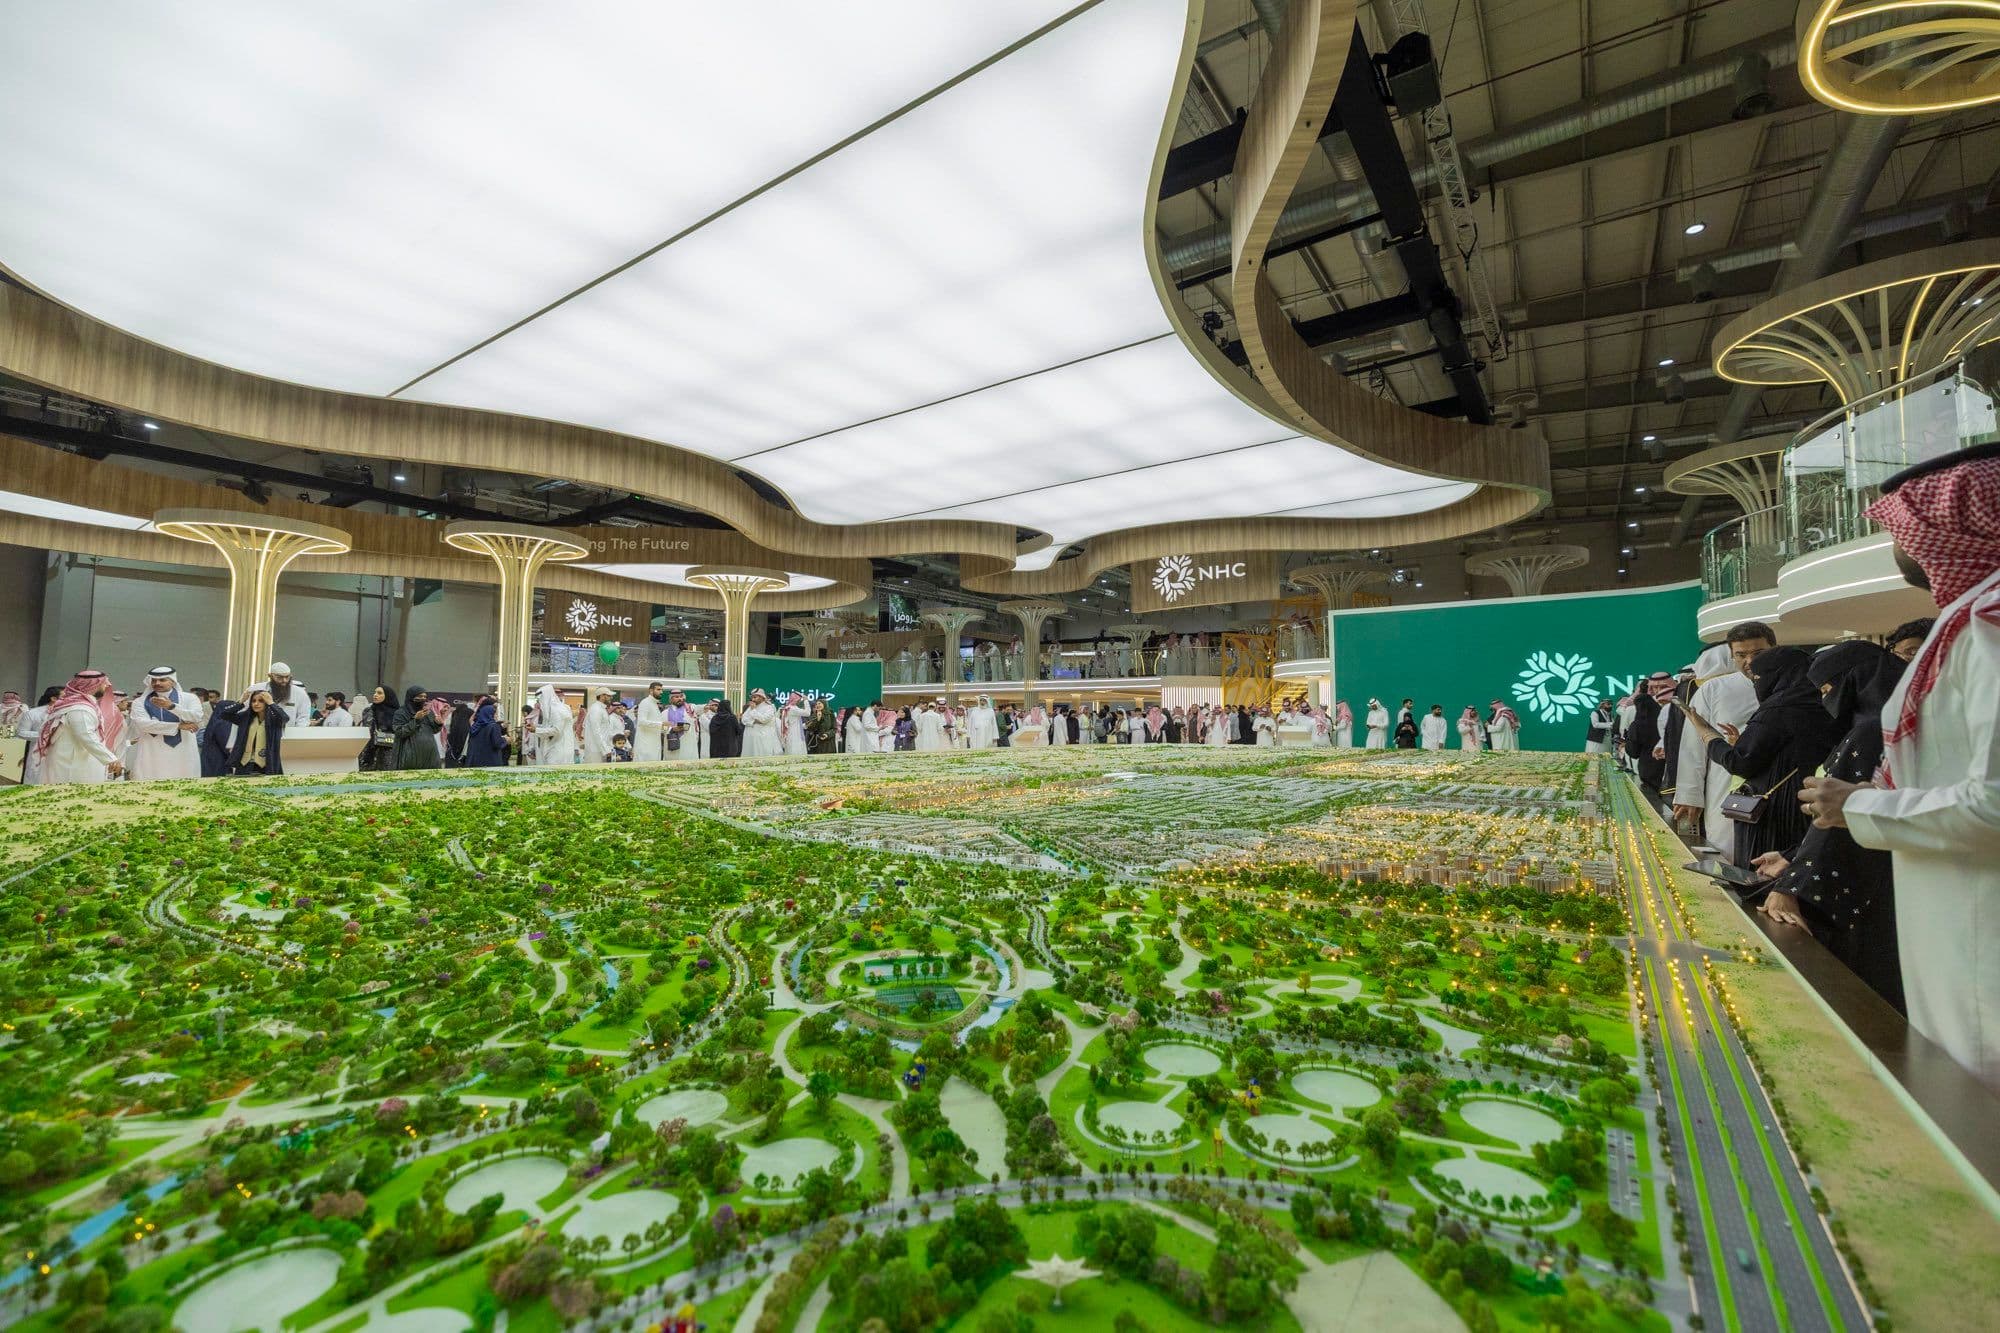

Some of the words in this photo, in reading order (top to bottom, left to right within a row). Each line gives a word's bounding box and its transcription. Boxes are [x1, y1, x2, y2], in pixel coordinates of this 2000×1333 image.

[610, 537, 637, 550] The
[641, 537, 690, 550] Future
[1199, 562, 1246, 581] NHC
[600, 614, 633, 627] NHC
